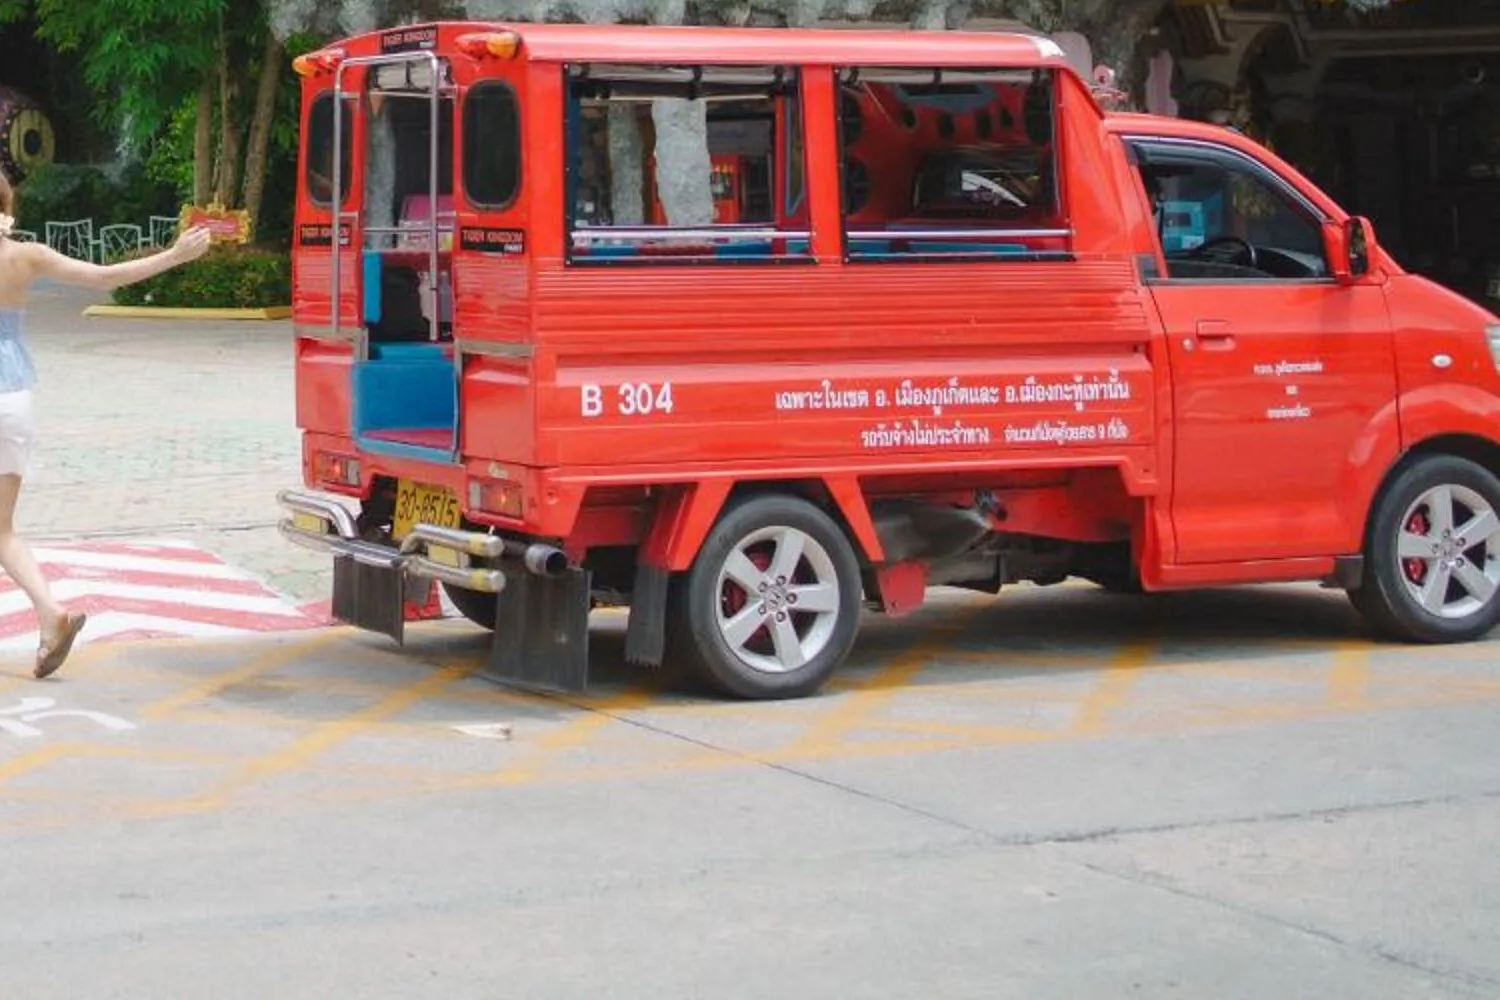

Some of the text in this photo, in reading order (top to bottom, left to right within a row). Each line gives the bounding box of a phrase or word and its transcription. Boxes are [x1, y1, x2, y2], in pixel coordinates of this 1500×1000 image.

[581, 380, 673, 417] B 304
[775, 378, 869, 409] เฉพาะในเขต
